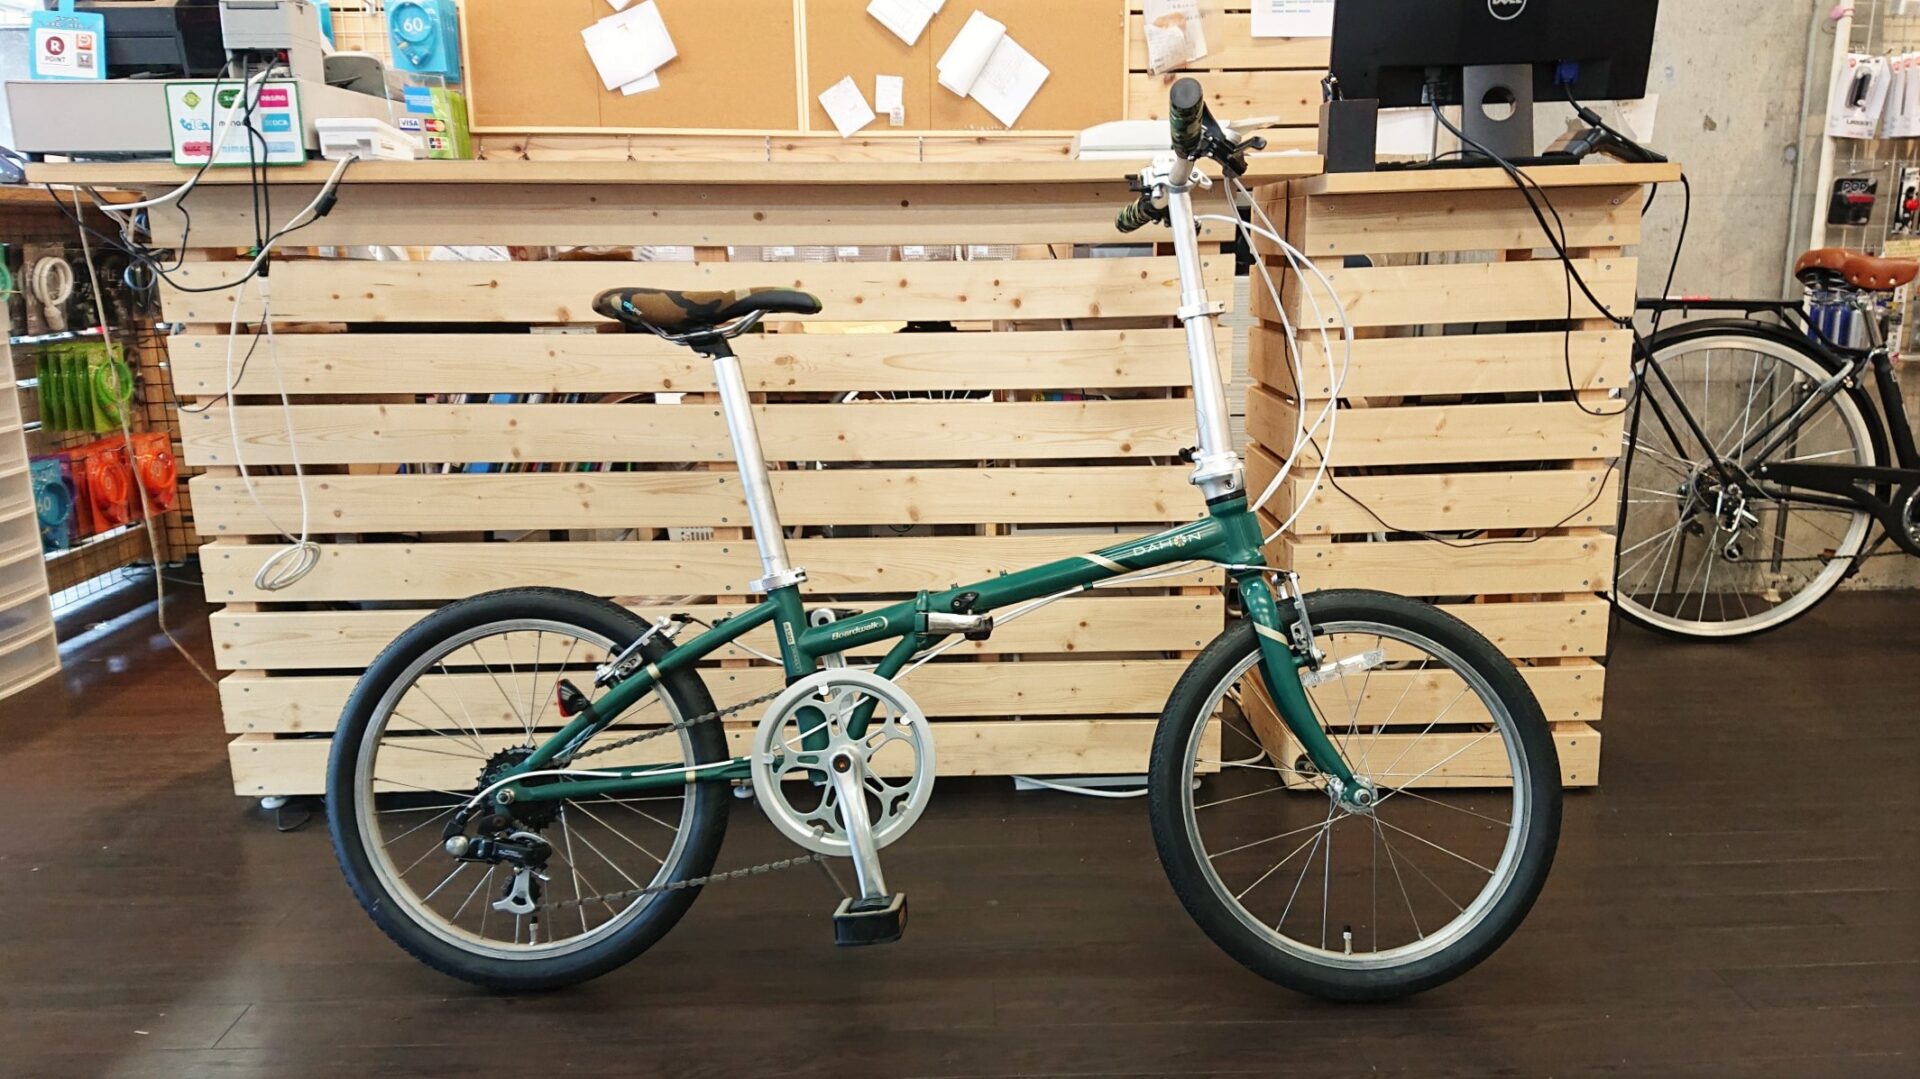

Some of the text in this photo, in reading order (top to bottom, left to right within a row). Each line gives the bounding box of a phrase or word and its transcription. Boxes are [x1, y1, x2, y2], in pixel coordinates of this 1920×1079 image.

[402, 16, 424, 33] 60
[401, 119, 419, 127] VISA
[1133, 531, 1202, 557] DAHON
[831, 620, 881, 641] Boardwalk
